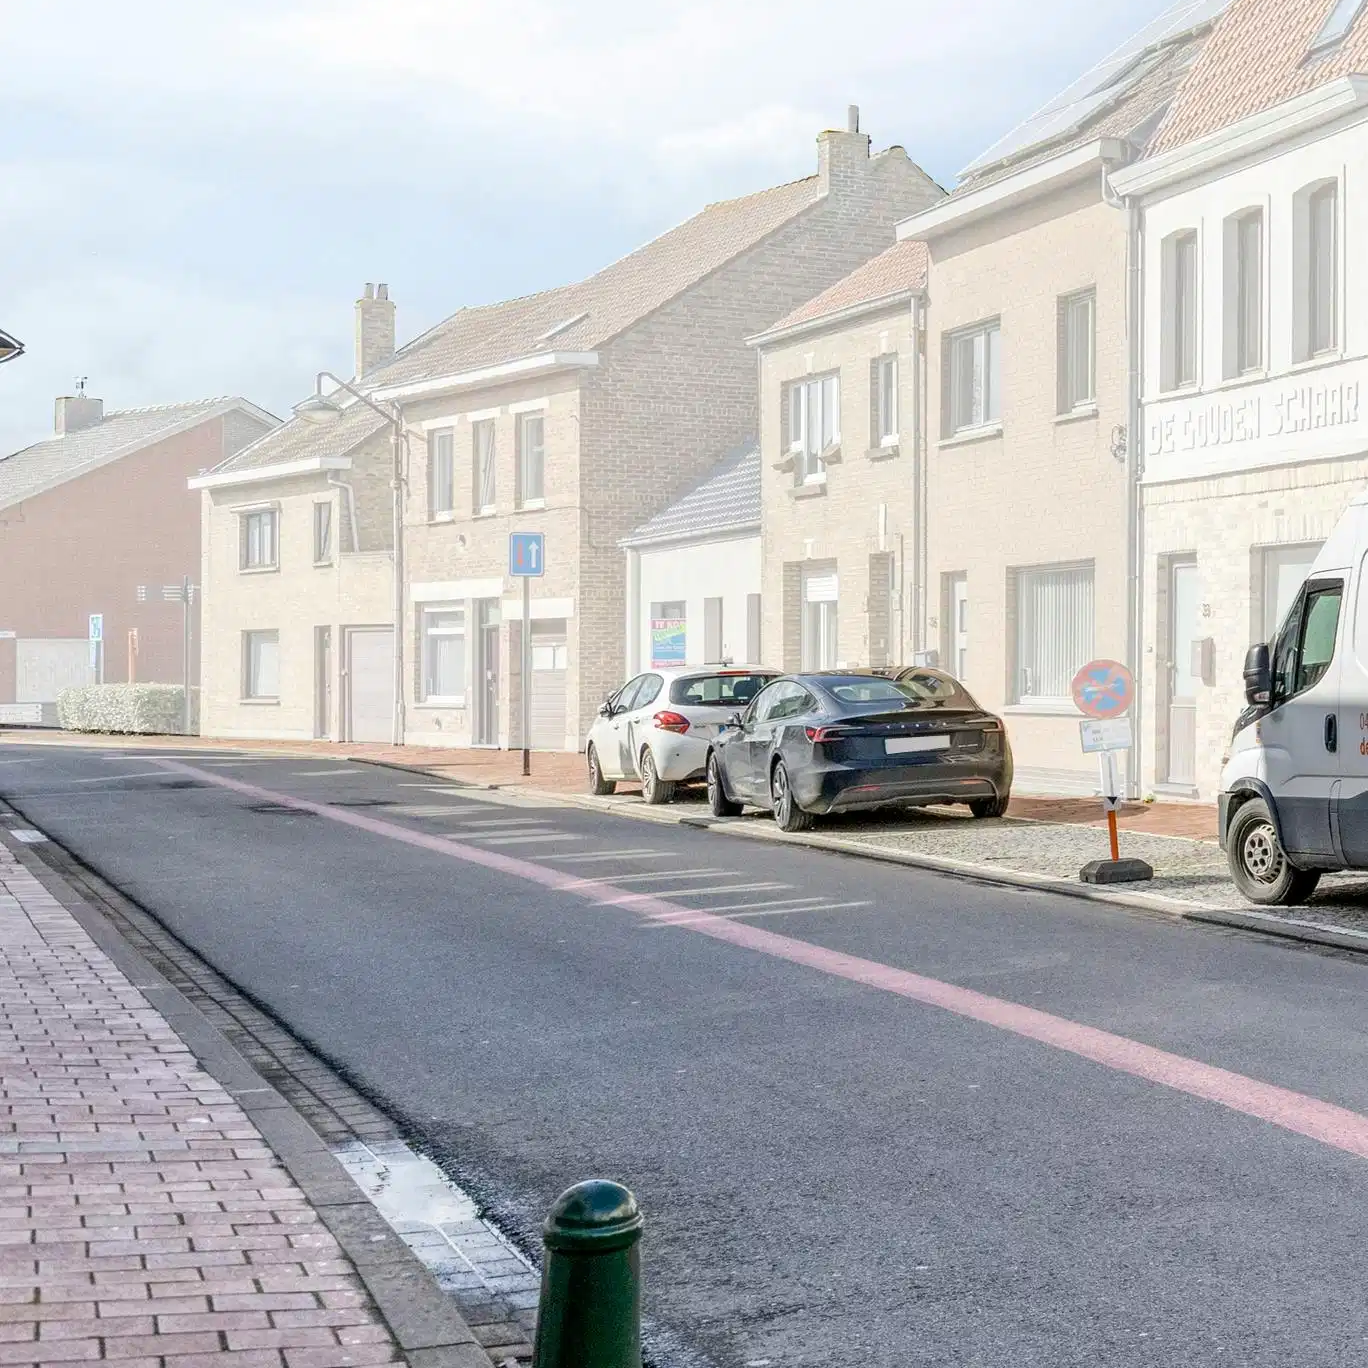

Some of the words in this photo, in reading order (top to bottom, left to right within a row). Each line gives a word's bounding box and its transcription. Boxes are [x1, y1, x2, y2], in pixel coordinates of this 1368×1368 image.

[1149, 413, 1176, 456] DE
[1181, 396, 1261, 452] GOUDEN
[1267, 380, 1360, 437] SCHAAR
